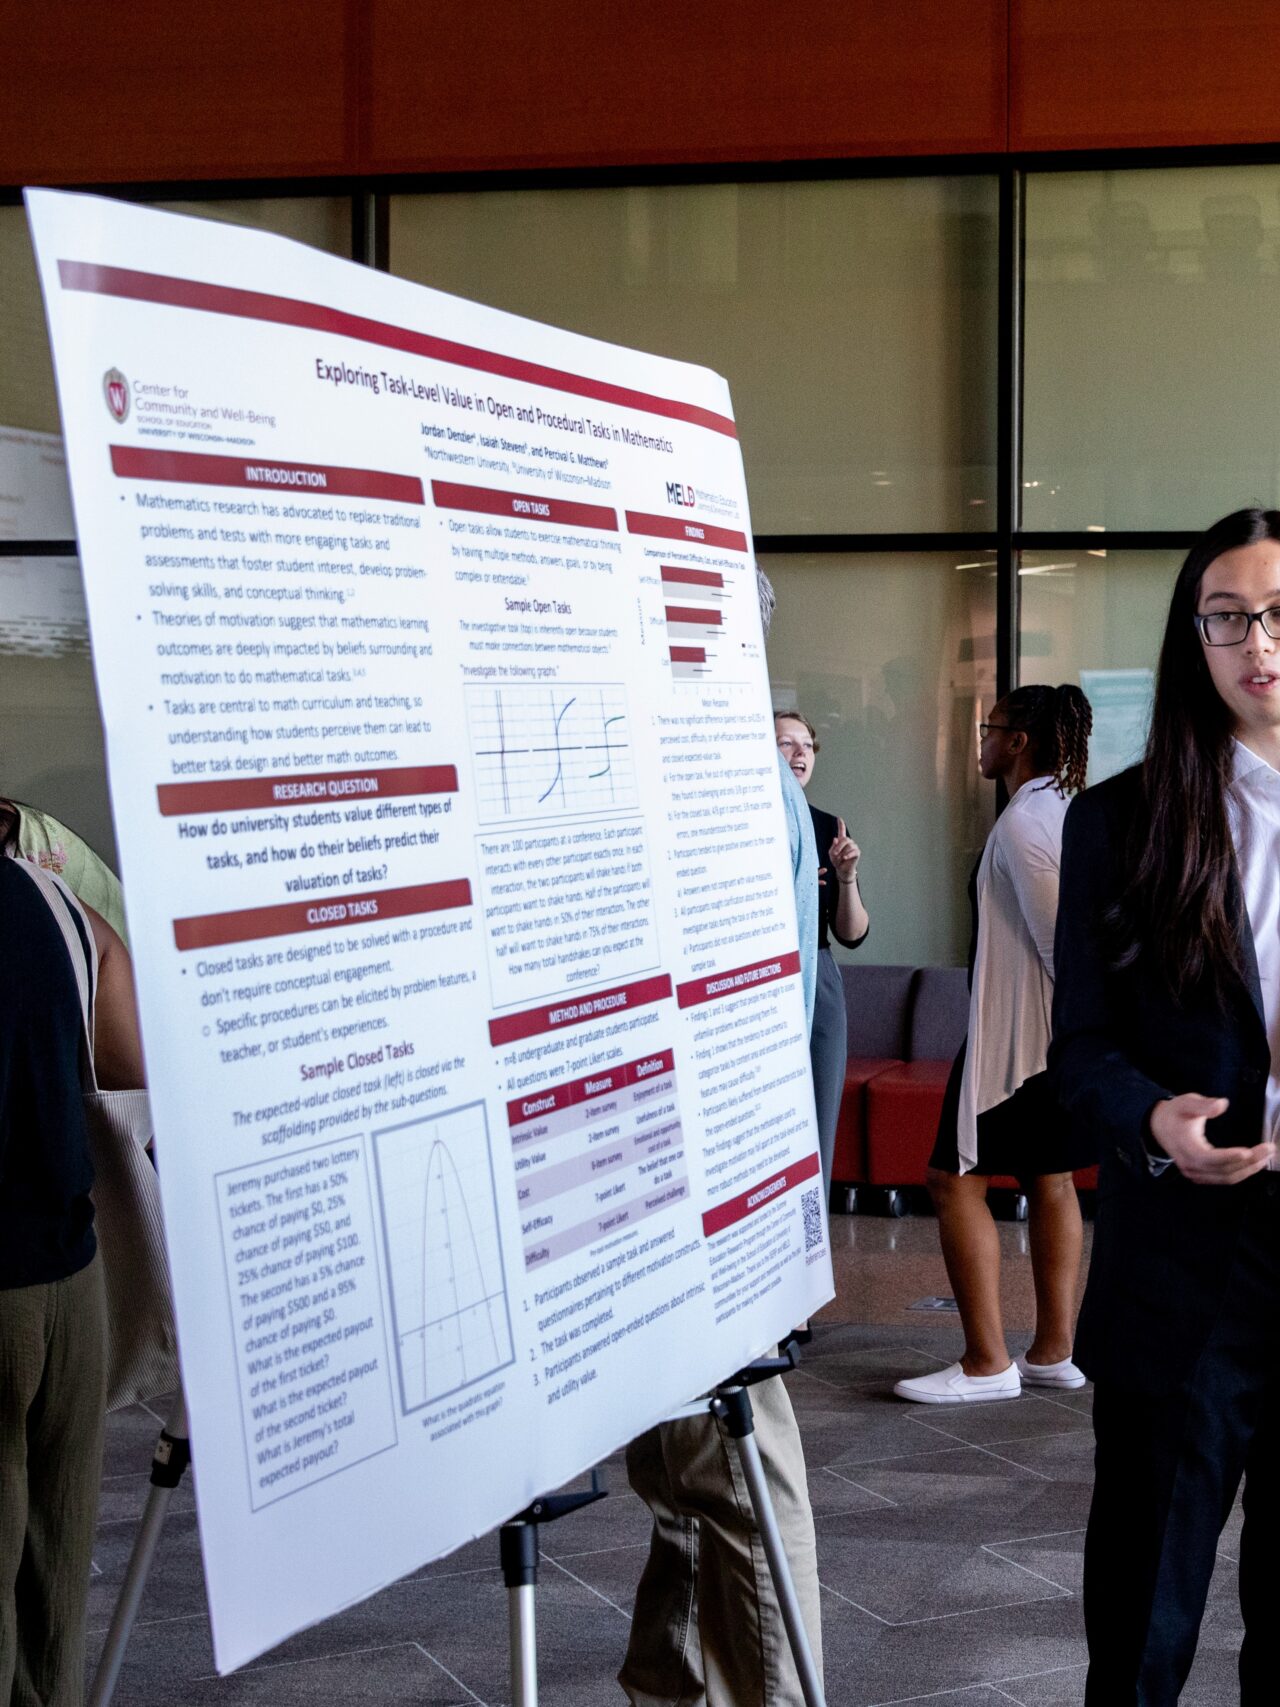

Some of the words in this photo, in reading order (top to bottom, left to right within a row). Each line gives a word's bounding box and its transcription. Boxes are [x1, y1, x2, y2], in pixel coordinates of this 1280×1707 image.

[133, 380, 171, 396] Center
[173, 386, 188, 399] for
[135, 397, 198, 418] Community
[200, 408, 218, 419] and
[221, 408, 276, 428] Well-Being
[316, 358, 380, 394] Exploring
[380, 372, 440, 402] Task-Level
[442, 386, 472, 410] Value
[474, 393, 485, 412] in
[487, 397, 514, 419] Open
[516, 406, 534, 423] and
[536, 408, 585, 434] Procedural
[586, 419, 610, 440] Tasks
[612, 424, 621, 442] in
[621, 428, 673, 453] Mathematics
[246, 466, 326, 486] INTRODUCTION
[666, 482, 695, 507] MELD
[136, 493, 210, 512] Mathematics
[213, 502, 259, 515] research
[262, 503, 280, 517] has
[283, 506, 333, 520] advocated
[336, 509, 346, 522] to
[349, 511, 381, 524] replace
[382, 514, 420, 528] traditional
[513, 500, 530, 513] OPEN
[530, 502, 551, 516] TASKS
[140, 524, 194, 540] problems
[198, 528, 218, 541] and
[220, 529, 246, 542] tests
[249, 530, 272, 543] with
[274, 534, 301, 545] more
[304, 536, 348, 551] engaging
[350, 536, 373, 549] tasks
[375, 540, 390, 550] and
[449, 519, 467, 532] Open
[468, 523, 484, 535] tasks
[486, 524, 502, 536] allow
[504, 528, 529, 540] students
[529, 531, 537, 541] to
[538, 533, 561, 544] exercise
[562, 536, 598, 548] mathematical
[600, 539, 622, 554] thinking
[146, 555, 215, 569] assessments
[217, 556, 240, 570] that
[242, 556, 272, 571] foster
[276, 560, 314, 572] student
[359, 563, 393, 578] develop
[395, 567, 426, 578] problem-
[149, 582, 190, 601] solving
[224, 585, 243, 598] and
[246, 587, 302, 601] conceptual
[505, 597, 531, 613] Sample
[533, 599, 551, 614] Open
[552, 600, 572, 614] Tasks
[152, 610, 202, 626] Theories
[204, 612, 216, 626] of
[219, 614, 276, 627] motivation
[278, 616, 316, 630] suggest
[318, 614, 338, 628] that
[341, 616, 398, 628] mathematics
[400, 618, 429, 633] learning
[156, 642, 213, 656] outcomes
[216, 644, 232, 656] are
[236, 642, 270, 657] deeply
[274, 642, 320, 657] impacted
[322, 642, 334, 656] by
[336, 641, 366, 655] beliefs
[369, 642, 418, 658] surrounding
[419, 645, 432, 656] and
[160, 672, 222, 685] motivation
[224, 672, 236, 684] to
[238, 670, 252, 684] do
[255, 670, 324, 683] mathematical
[164, 700, 196, 715] Tasks
[199, 702, 216, 714] are
[219, 699, 256, 713] central
[258, 700, 270, 712] to
[273, 697, 299, 711] math
[302, 696, 353, 710] curriculum
[356, 696, 372, 708] and
[413, 697, 422, 707] so
[168, 727, 248, 744] understanding
[250, 727, 272, 740] how
[276, 726, 319, 739] students
[322, 725, 361, 739] perceive
[363, 722, 386, 734] them
[389, 723, 403, 734] can
[406, 721, 422, 733] lead
[422, 721, 431, 732] to
[273, 782, 326, 799] RESEARCH
[328, 778, 378, 796] QUESTION
[178, 823, 208, 838] How
[211, 819, 227, 836] do
[230, 814, 289, 834] university
[292, 810, 342, 828] students
[344, 807, 372, 822] value
[376, 803, 417, 819] different
[418, 803, 442, 817] types
[444, 798, 451, 813] of
[246, 848, 268, 865] and
[271, 846, 296, 861] how
[300, 843, 315, 858] do
[317, 840, 344, 856] their
[347, 835, 382, 853] beliefs
[384, 832, 418, 851] predict
[419, 831, 439, 844] their
[285, 873, 340, 892] valuation
[342, 868, 356, 885] of
[356, 864, 387, 883] tasks?
[307, 904, 348, 924] CLOSED
[348, 900, 378, 916] TASKS
[196, 958, 233, 978] Closed
[235, 954, 264, 970] tasks
[266, 952, 283, 966] are
[286, 942, 332, 962] designed
[333, 942, 345, 954] to
[346, 939, 359, 952] be
[361, 932, 390, 949] solved
[392, 929, 410, 943] with
[412, 930, 418, 940] a
[420, 923, 457, 940] procedure
[459, 918, 472, 932] and
[232, 984, 272, 1000] require
[274, 970, 331, 993] conceptual
[549, 1006, 579, 1024] METHOD
[579, 1002, 593, 1016] AND
[593, 992, 627, 1012] PROCEDURE
[300, 1057, 344, 1081] Sample
[347, 1046, 384, 1070] Closed
[385, 1041, 414, 1060] Tasks
[634, 1059, 666, 1077] Definition
[584, 1078, 615, 1094] Measure
[522, 1095, 556, 1116] Construct
[228, 1178, 262, 1196] Jeremy
[263, 1160, 310, 1188] purchased
[312, 1158, 329, 1170] two
[331, 1149, 359, 1165] lottery
[534, 1281, 572, 1306] Participants
[573, 1265, 600, 1288] observed
[600, 1264, 605, 1274] a
[606, 1254, 626, 1271] sample
[626, 1246, 638, 1260] task
[639, 1240, 649, 1254] and
[650, 1228, 675, 1249] answered
